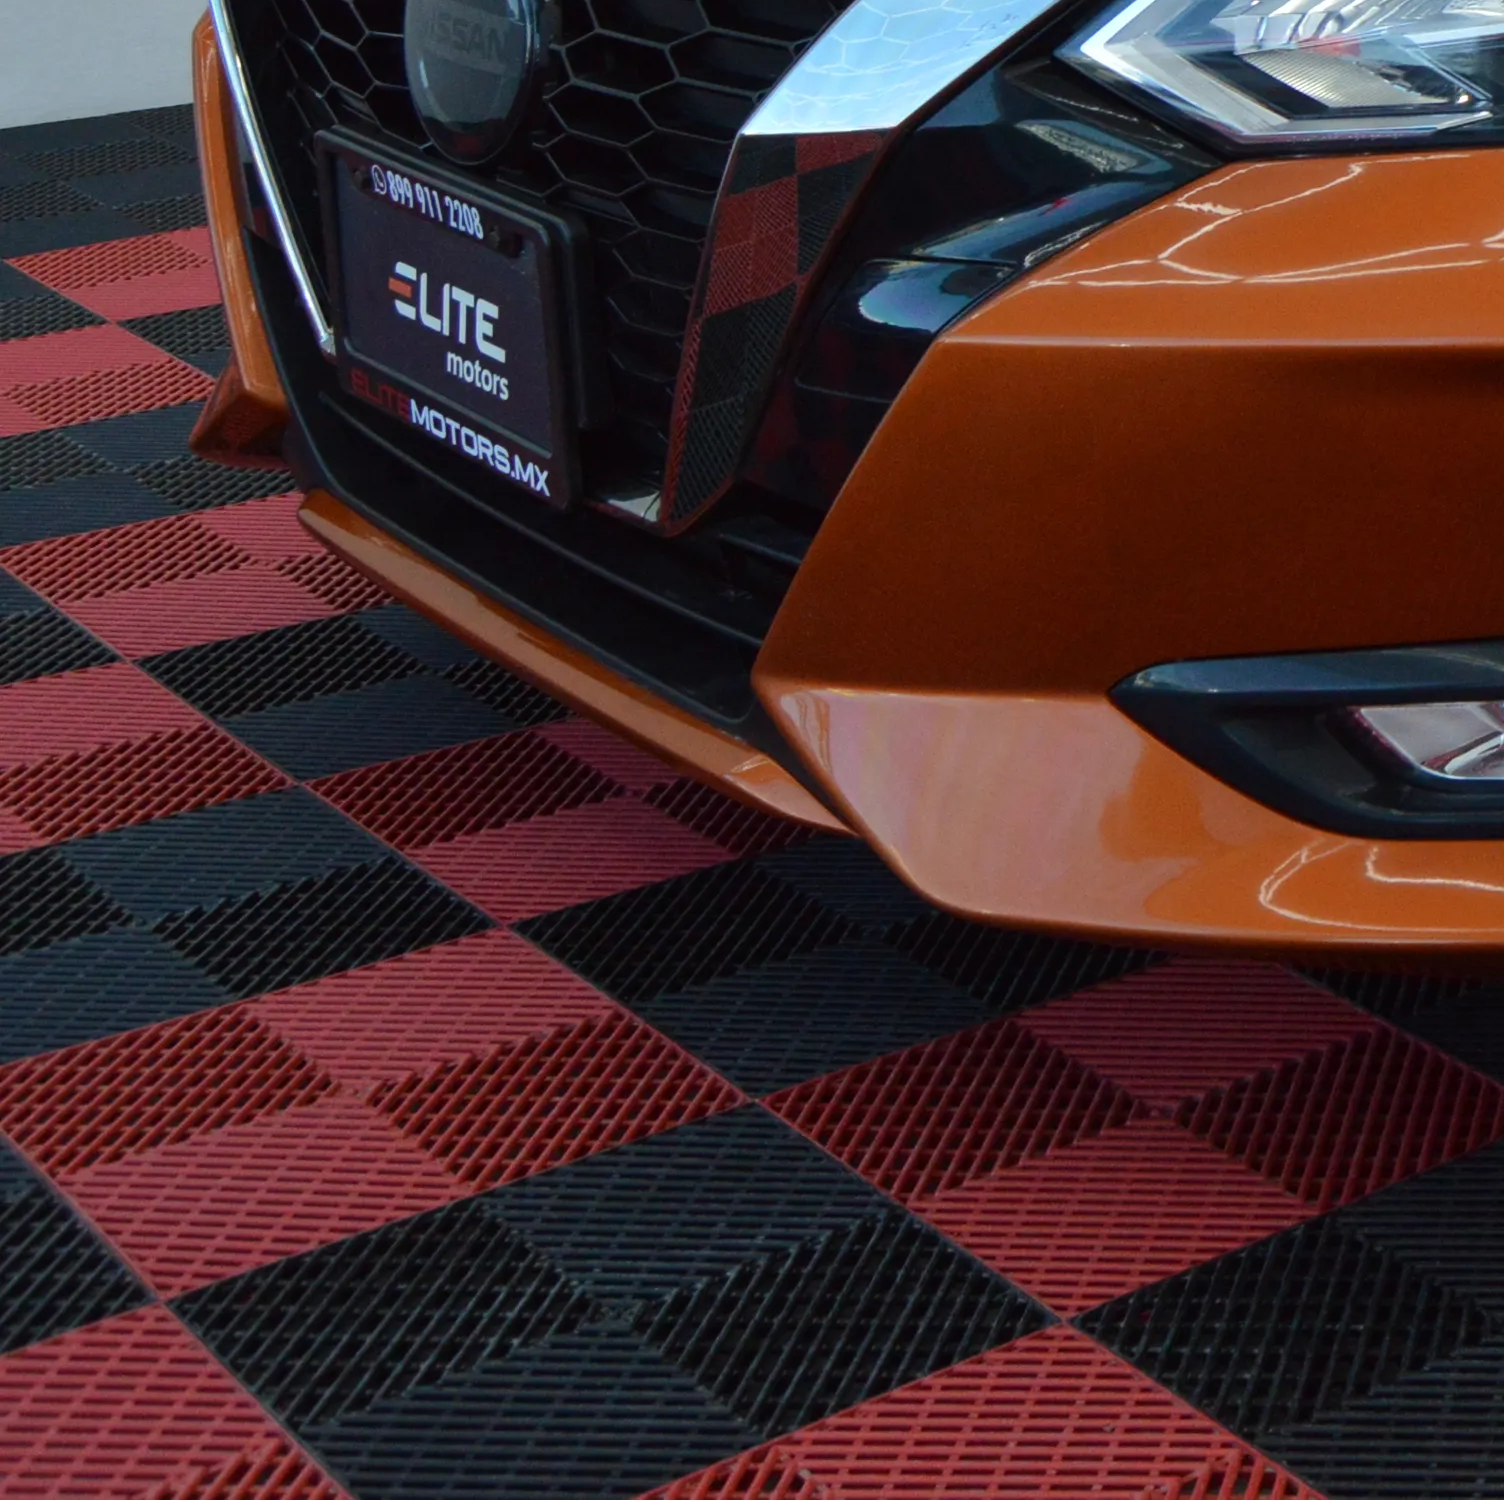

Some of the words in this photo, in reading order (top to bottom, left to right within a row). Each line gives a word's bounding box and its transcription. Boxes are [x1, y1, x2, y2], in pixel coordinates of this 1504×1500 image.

[386, 170, 414, 209] 899
[414, 182, 444, 223] 911
[445, 195, 485, 241] 2208
[388, 261, 507, 364] ELITE
[446, 351, 510, 401] motors
